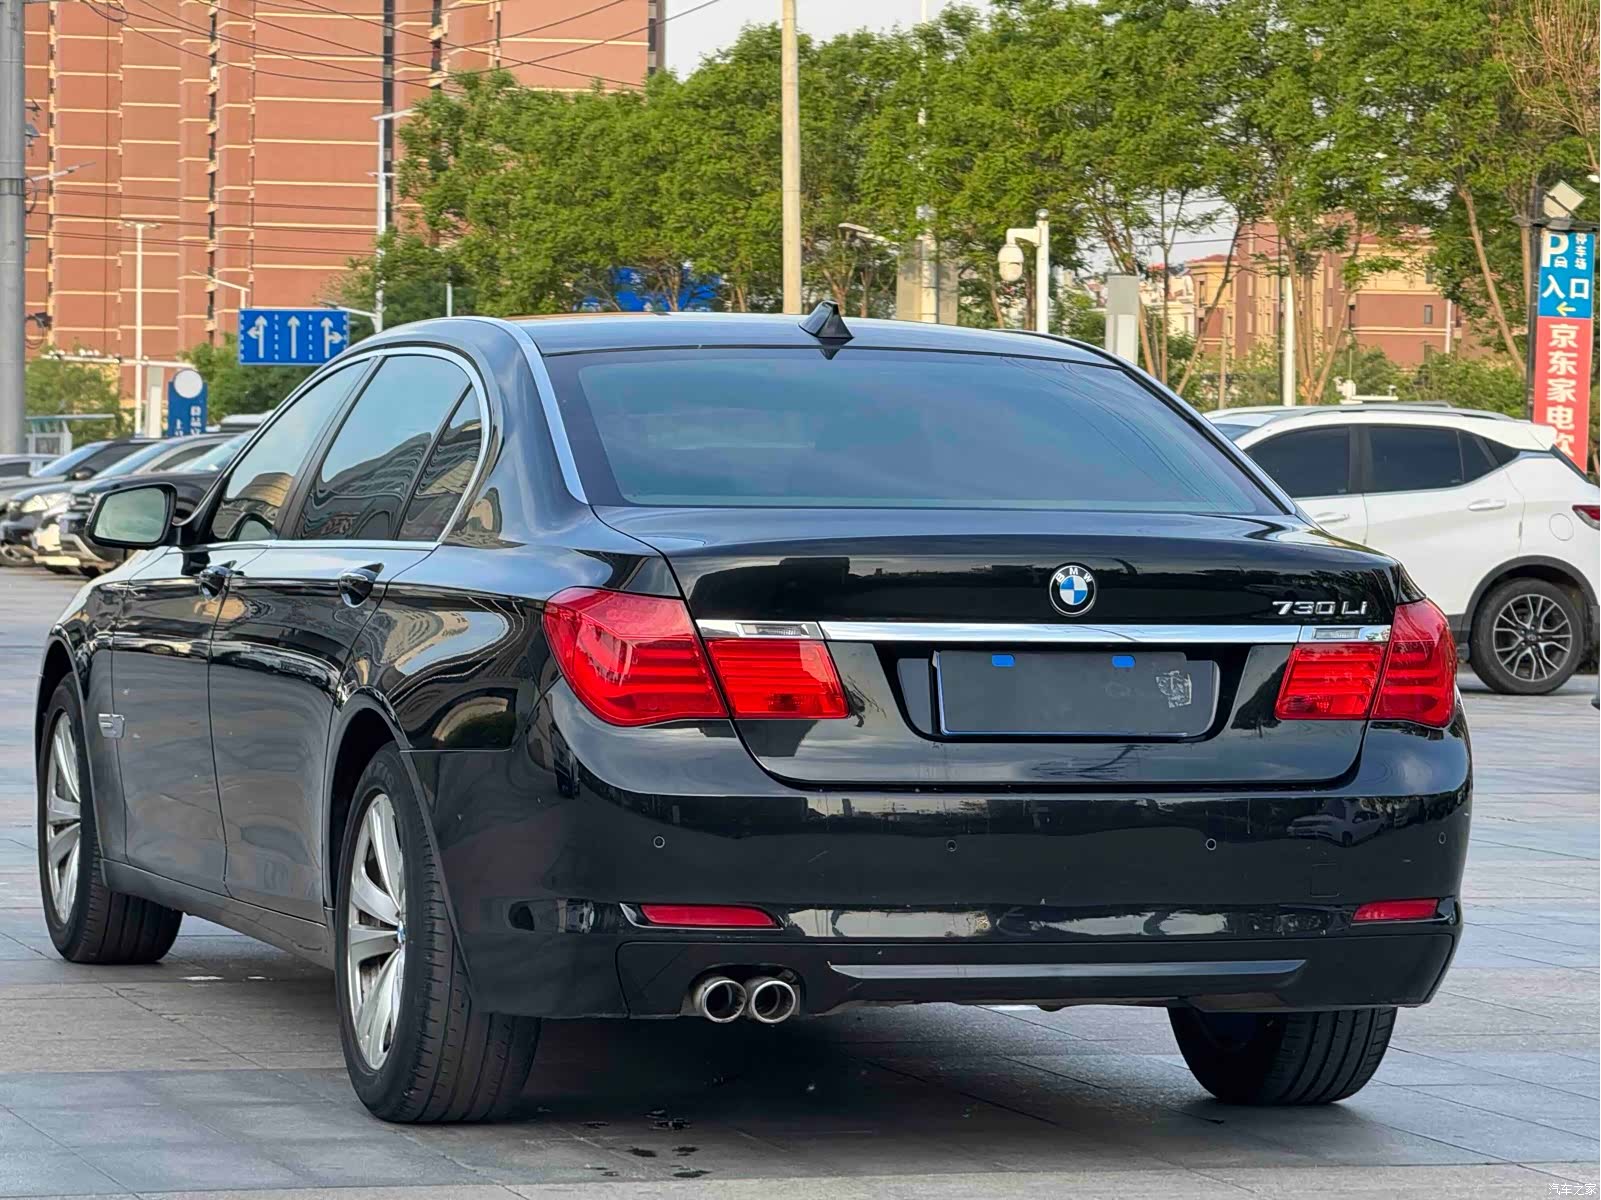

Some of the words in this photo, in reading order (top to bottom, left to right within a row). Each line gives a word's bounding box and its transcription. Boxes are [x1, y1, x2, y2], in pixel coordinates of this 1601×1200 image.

[1541, 231, 1569, 268] P
[1575, 233, 1588, 270] 停车场
[1542, 274, 1590, 300] 入口
[1055, 567, 1093, 583] BMW
